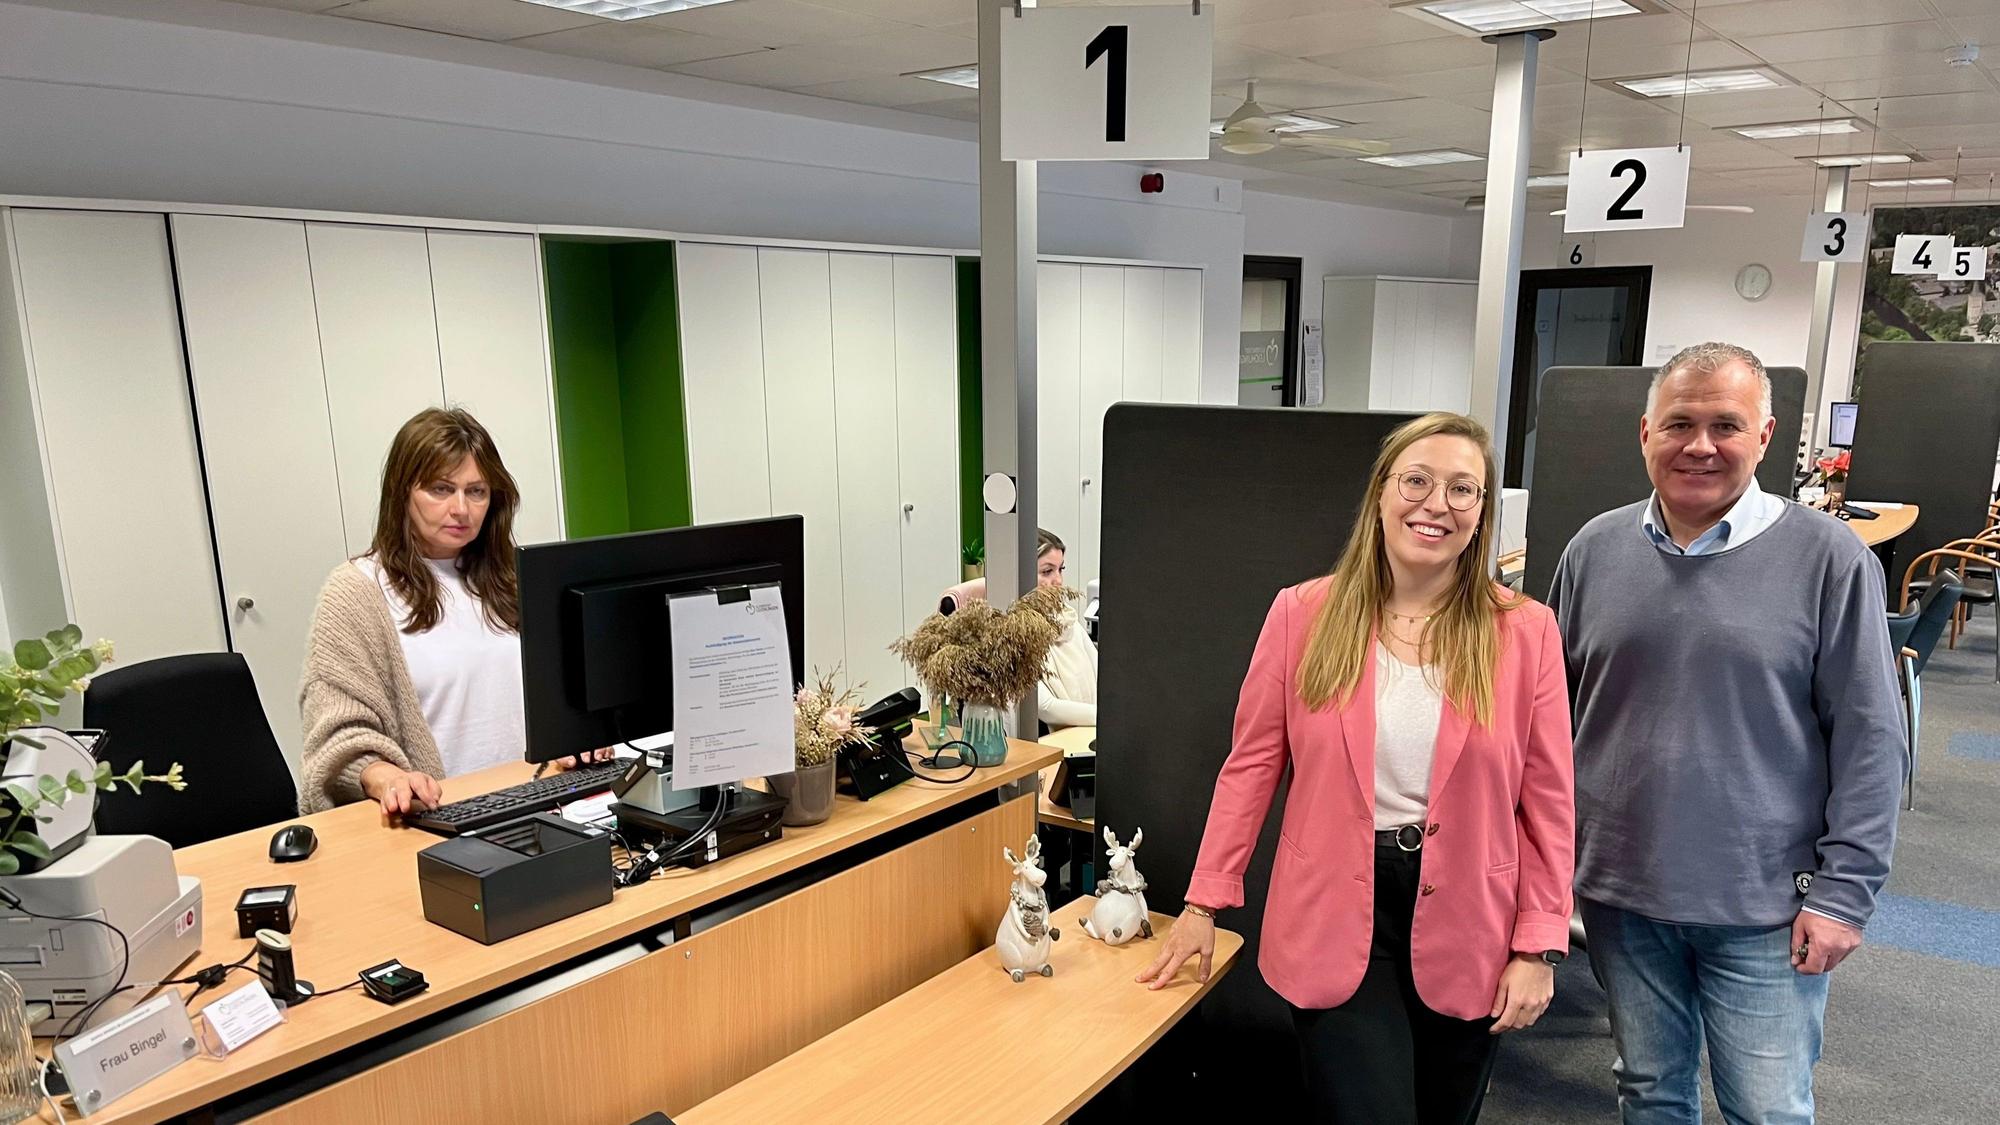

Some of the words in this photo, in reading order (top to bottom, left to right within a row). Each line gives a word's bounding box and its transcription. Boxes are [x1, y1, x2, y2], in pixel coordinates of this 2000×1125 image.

[1086, 25, 1128, 142] 1
[1606, 158, 1647, 221] 2
[1569, 244, 1583, 265] 6
[1823, 217, 1847, 257] 3
[1911, 240, 1932, 270] 4
[1954, 251, 1971, 277] 5
[99, 1050, 129, 1073] Frau
[129, 1027, 167, 1057] Bingel
